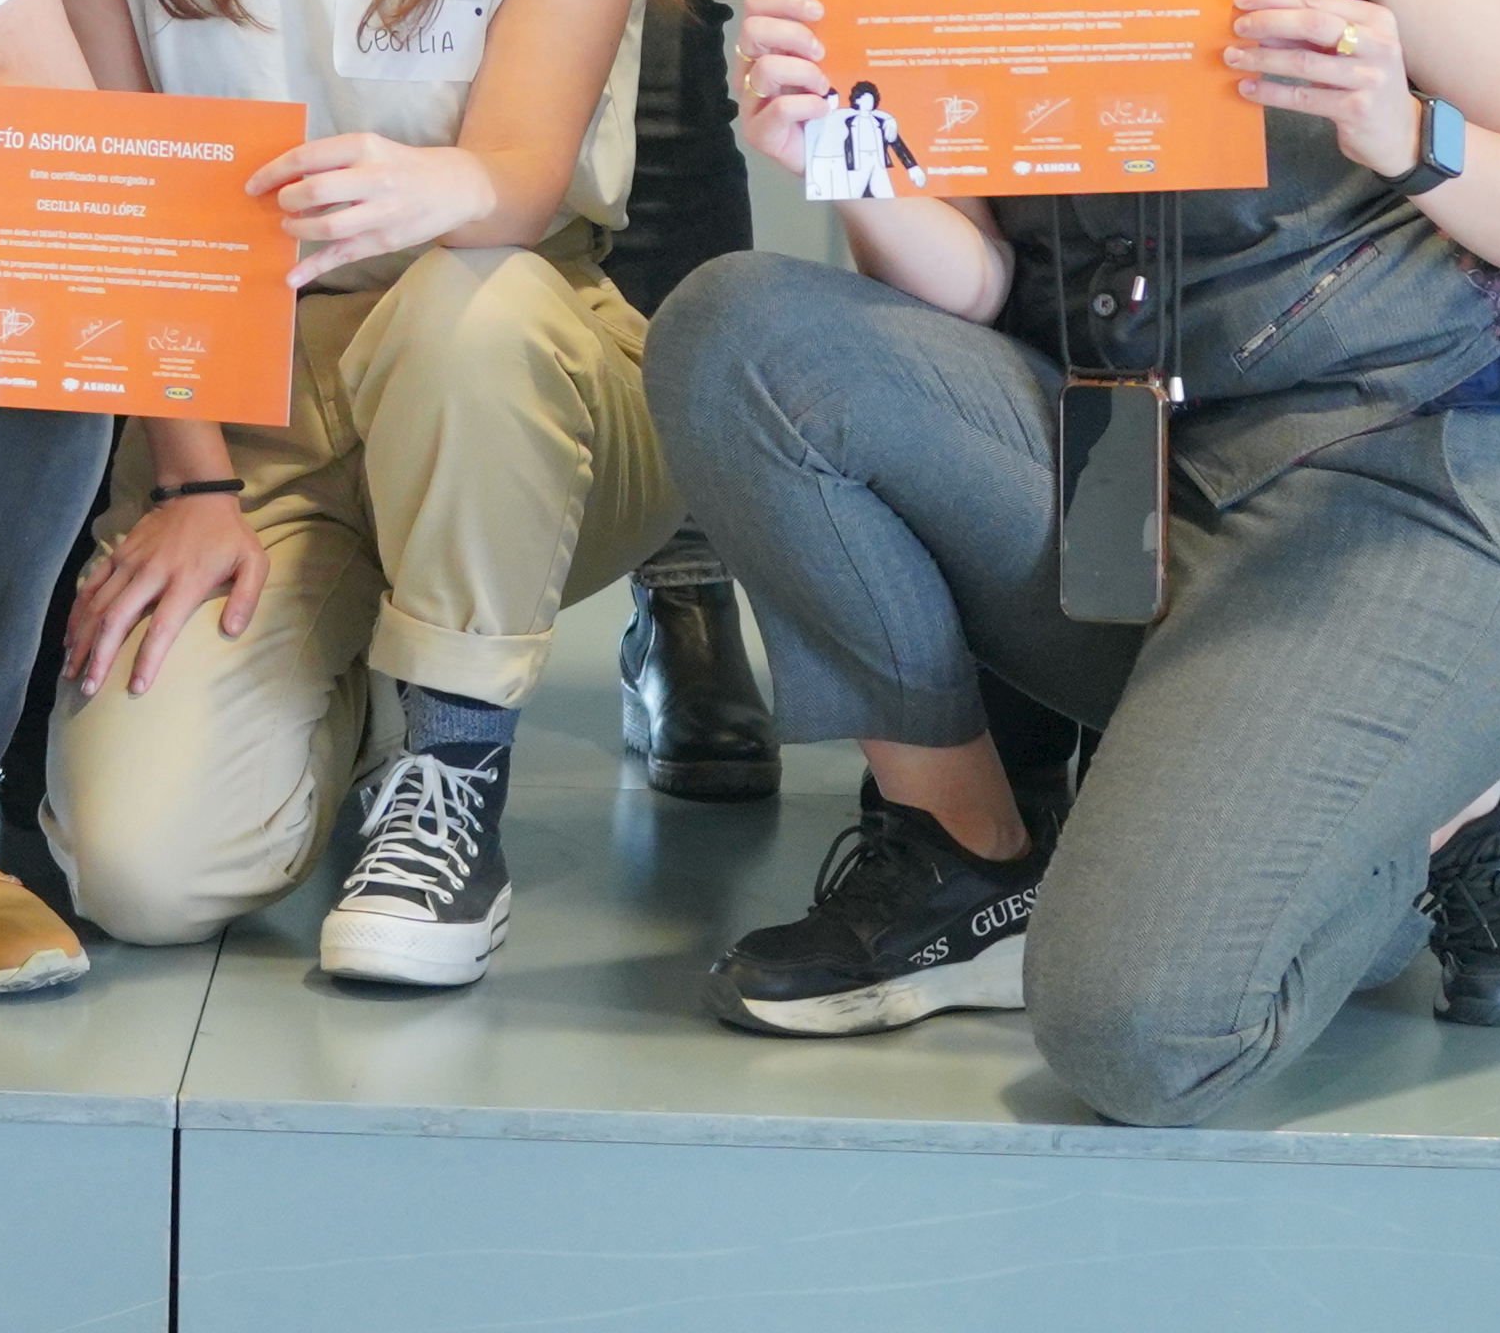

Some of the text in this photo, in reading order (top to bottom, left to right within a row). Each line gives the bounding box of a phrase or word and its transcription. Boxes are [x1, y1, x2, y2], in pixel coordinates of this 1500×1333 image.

[29, 132, 97, 152] ASHOKA
[101, 136, 235, 162] CHANGEMAKERS
[1035, 162, 1081, 172] ASHOKA
[29, 169, 50, 180] Este
[49, 171, 97, 182] certificado
[109, 175, 149, 187] otorgado
[83, 382, 125, 393] ASHOKA
